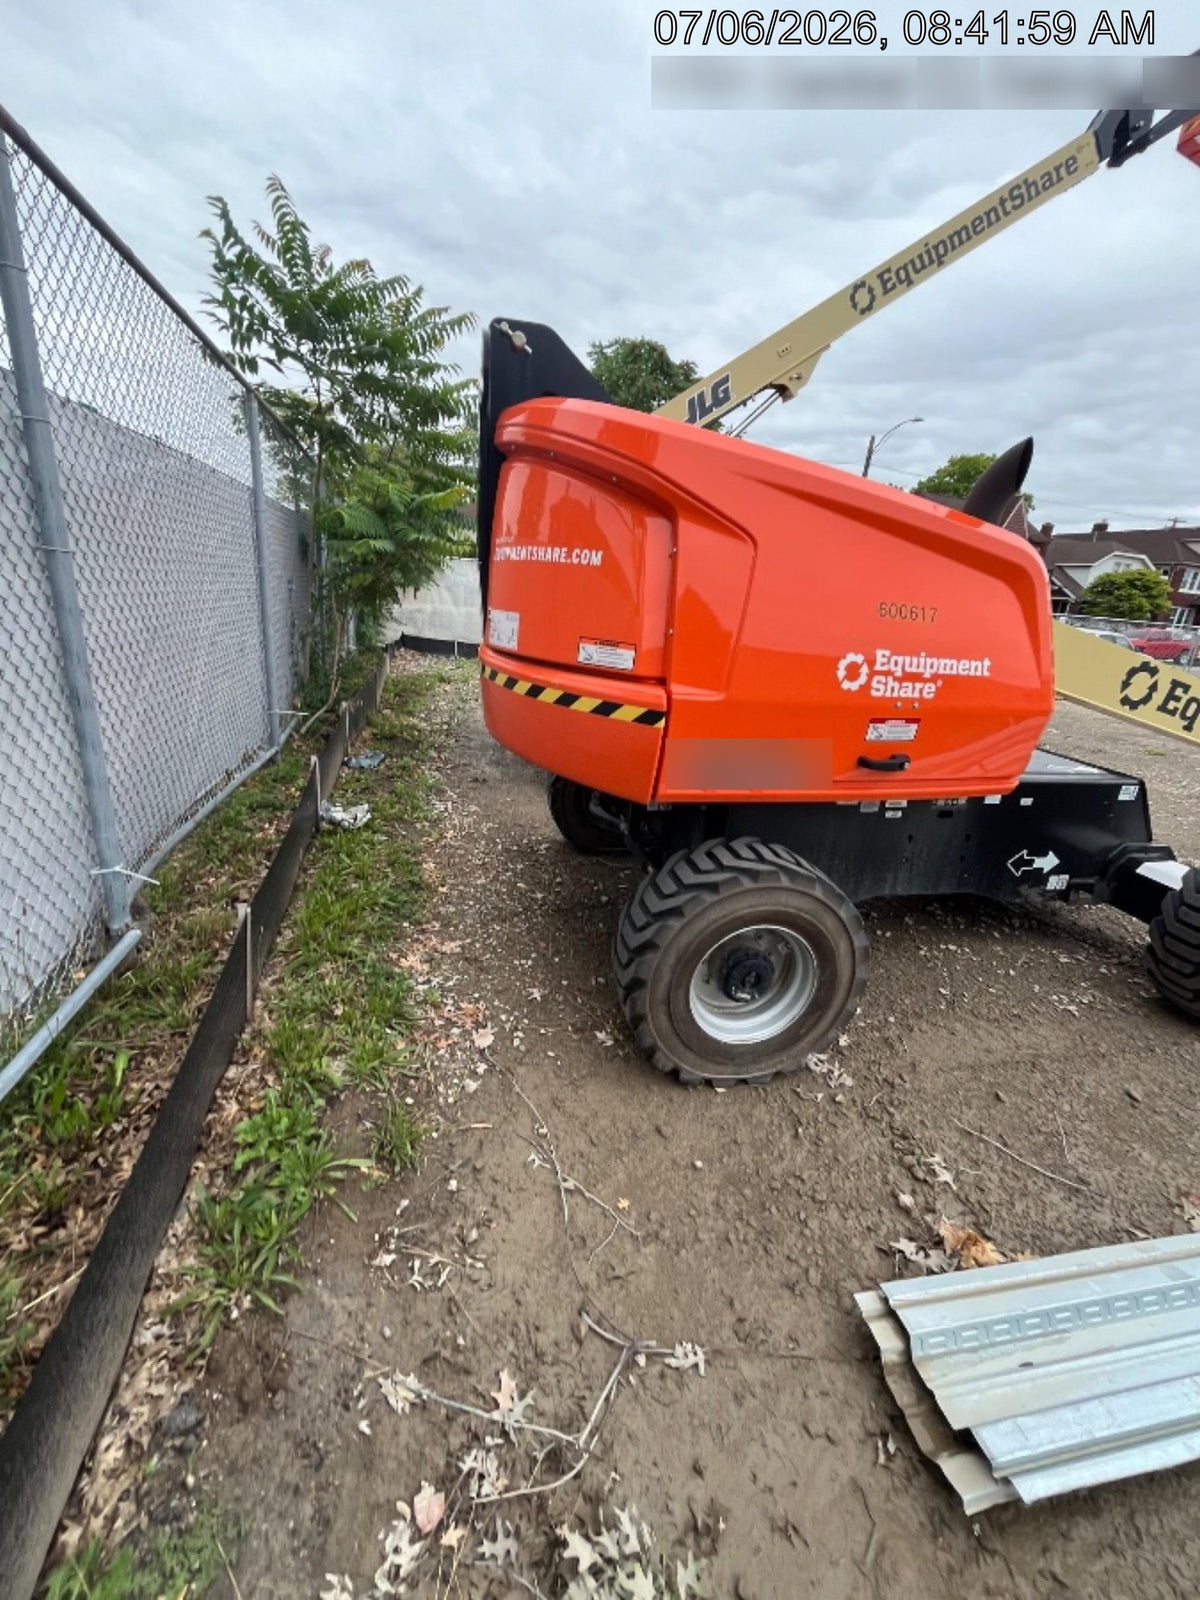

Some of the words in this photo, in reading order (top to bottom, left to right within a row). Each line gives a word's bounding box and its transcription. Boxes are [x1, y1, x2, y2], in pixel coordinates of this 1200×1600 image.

[876, 154, 1080, 296] EquipmentShare
[684, 371, 733, 424] JLG
[878, 601, 938, 623] 600617
[874, 649, 992, 678] Equipment
[870, 675, 937, 699] Share
